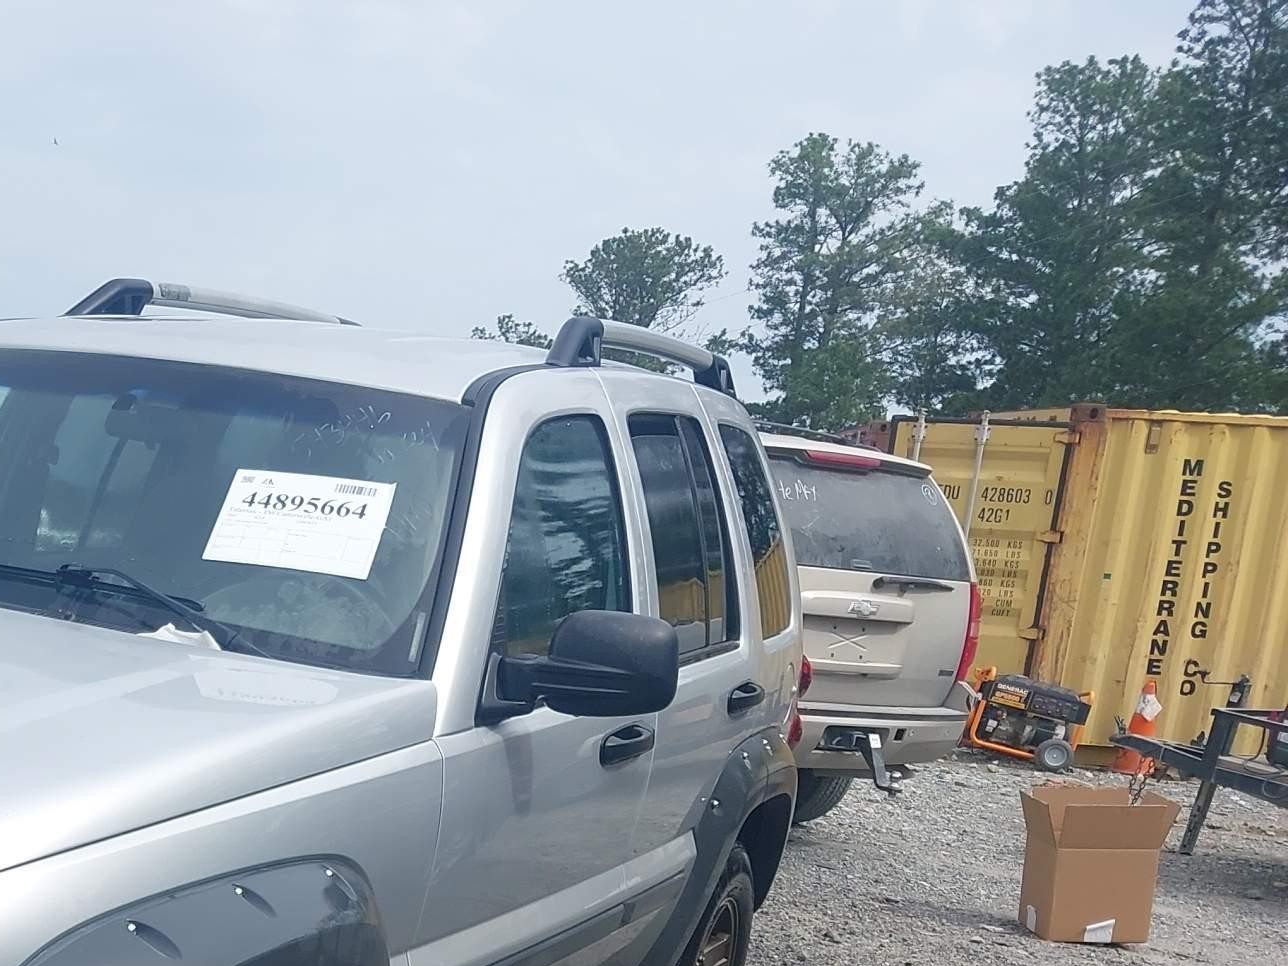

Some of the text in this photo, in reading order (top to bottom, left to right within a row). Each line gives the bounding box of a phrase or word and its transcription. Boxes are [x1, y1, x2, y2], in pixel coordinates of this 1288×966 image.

[242, 491, 368, 520] 44895664
[981, 487, 1032, 504] 428603
[1044, 489, 1053, 505] 0
[977, 507, 1010, 523] 42G1
[1179, 481, 1233, 696] SHIPPING CO
